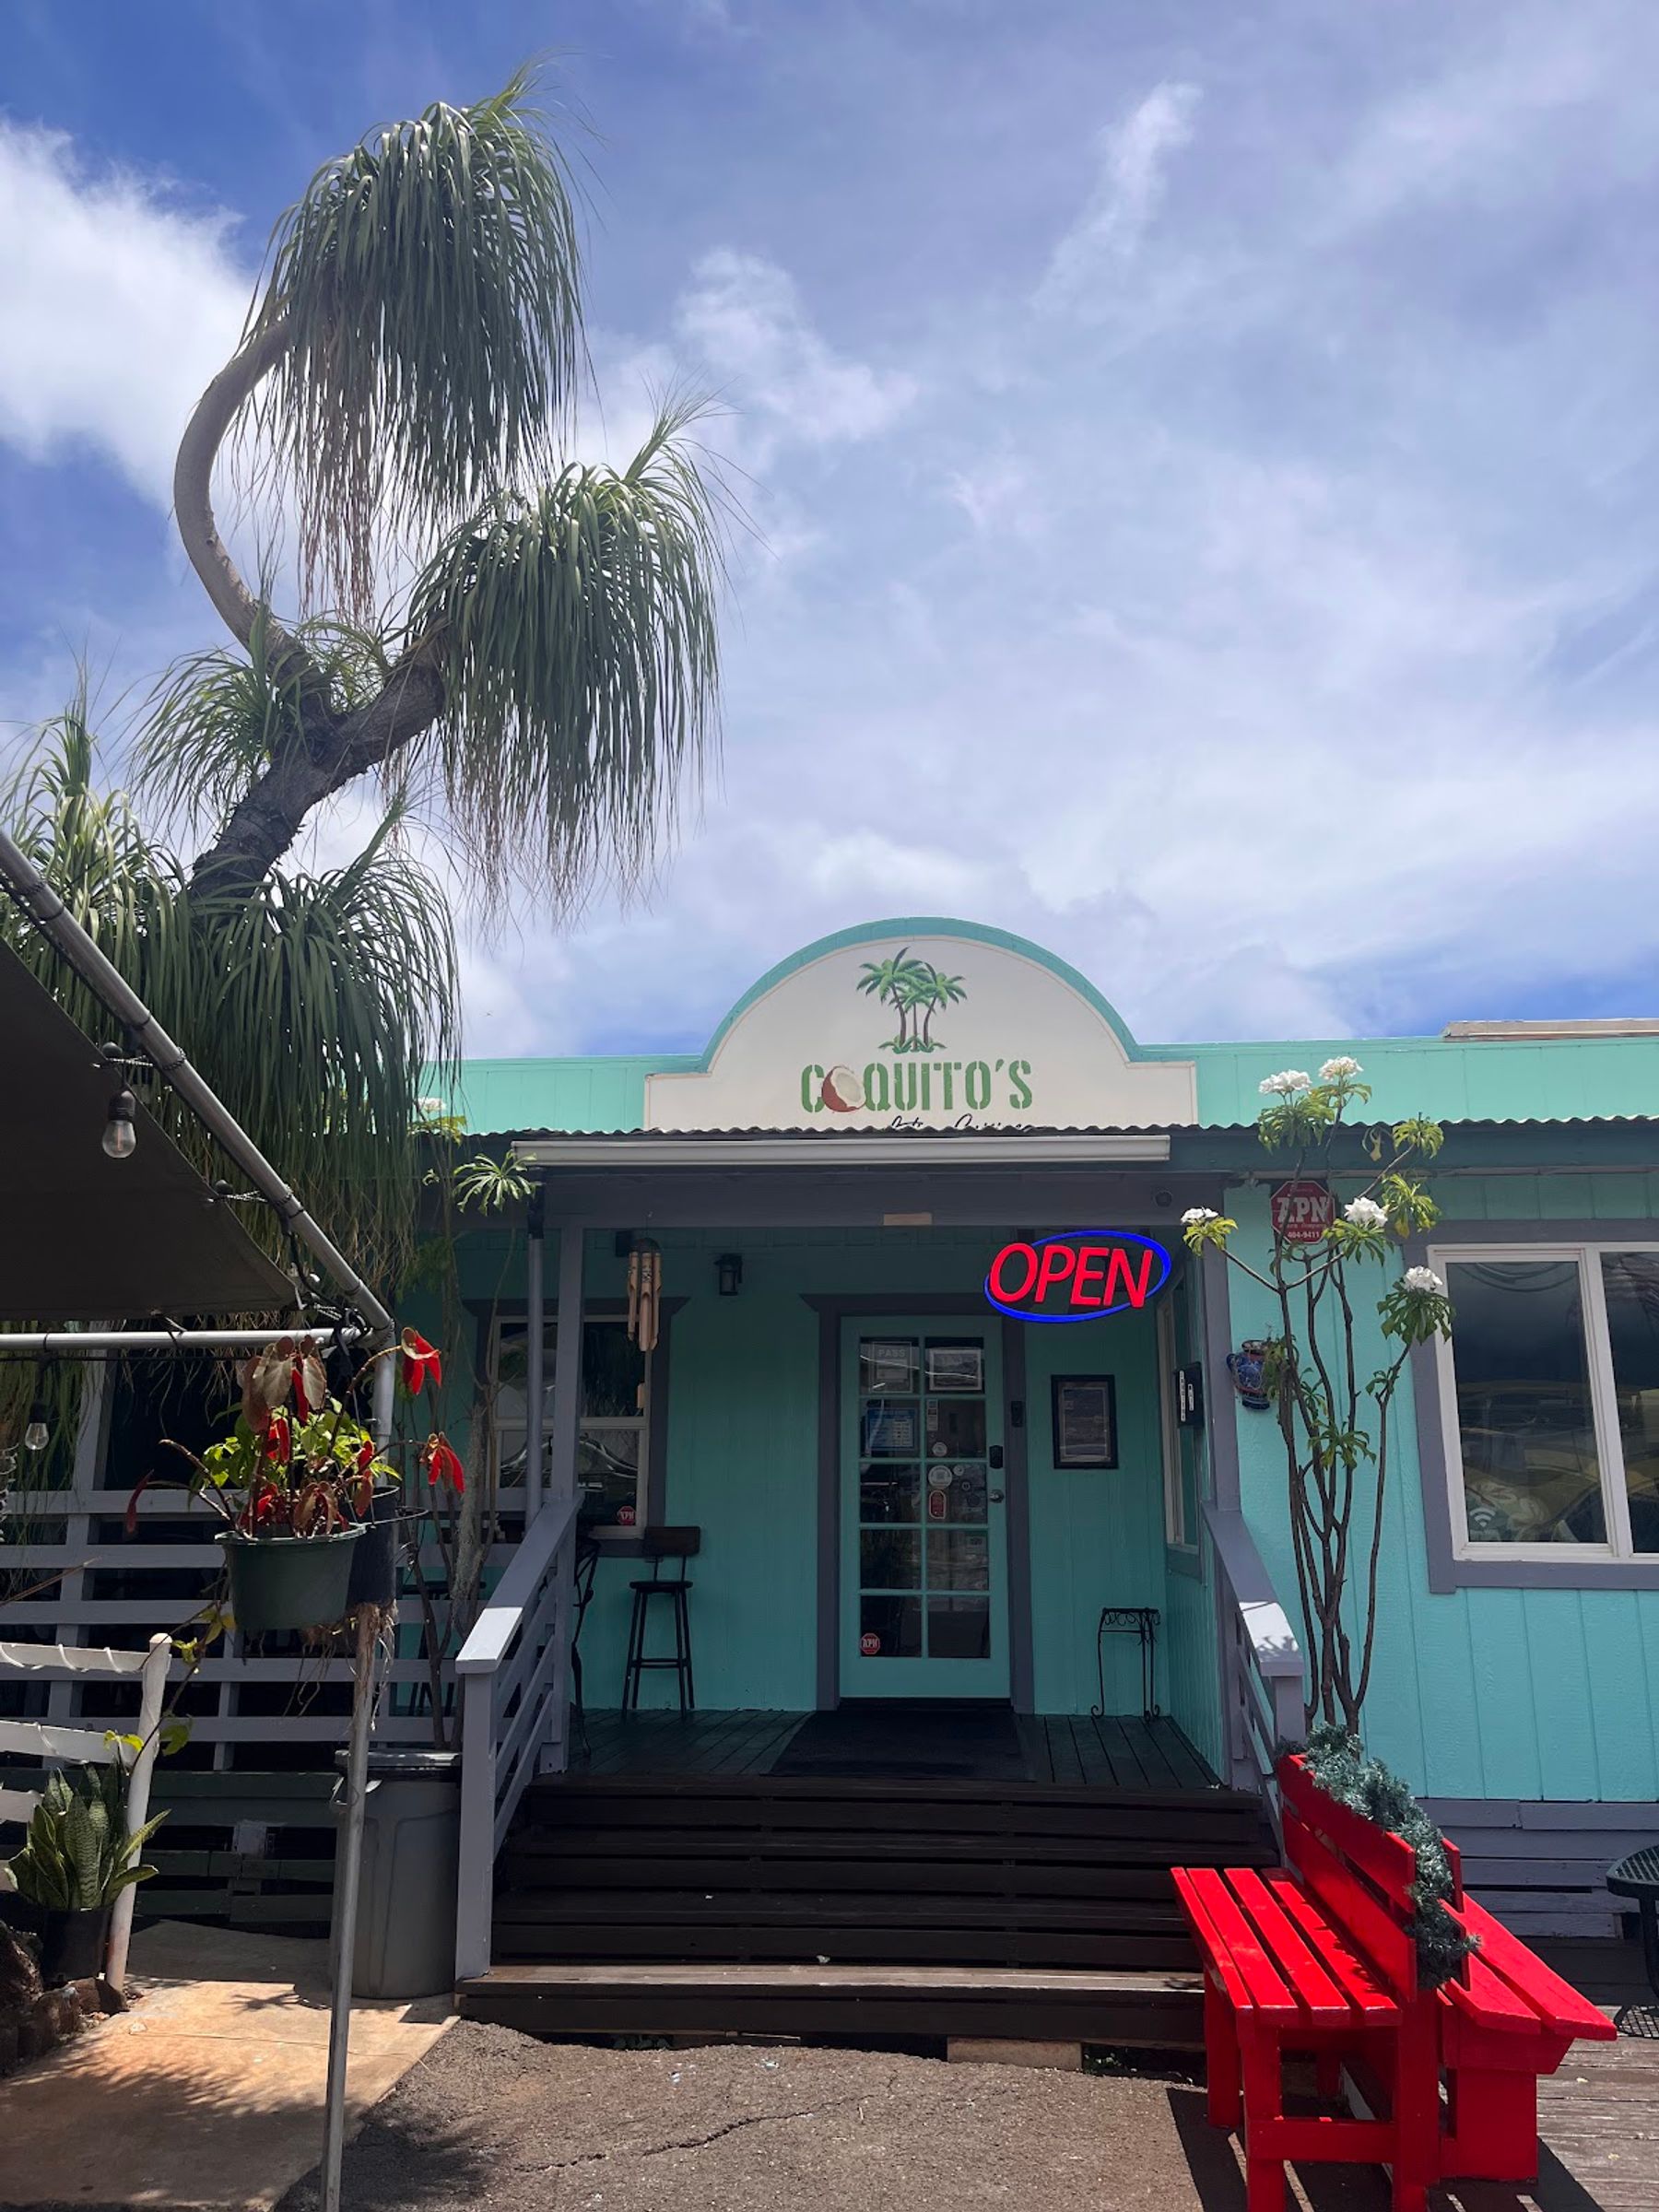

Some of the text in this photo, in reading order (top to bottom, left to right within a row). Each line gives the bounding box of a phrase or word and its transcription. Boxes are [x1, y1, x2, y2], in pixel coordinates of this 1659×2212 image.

[801, 1059, 1033, 1113] COQUITO'S
[1277, 1196, 1328, 1223] APN
[989, 1242, 1155, 1309] OPEN
[877, 1348, 906, 1358] PASS
